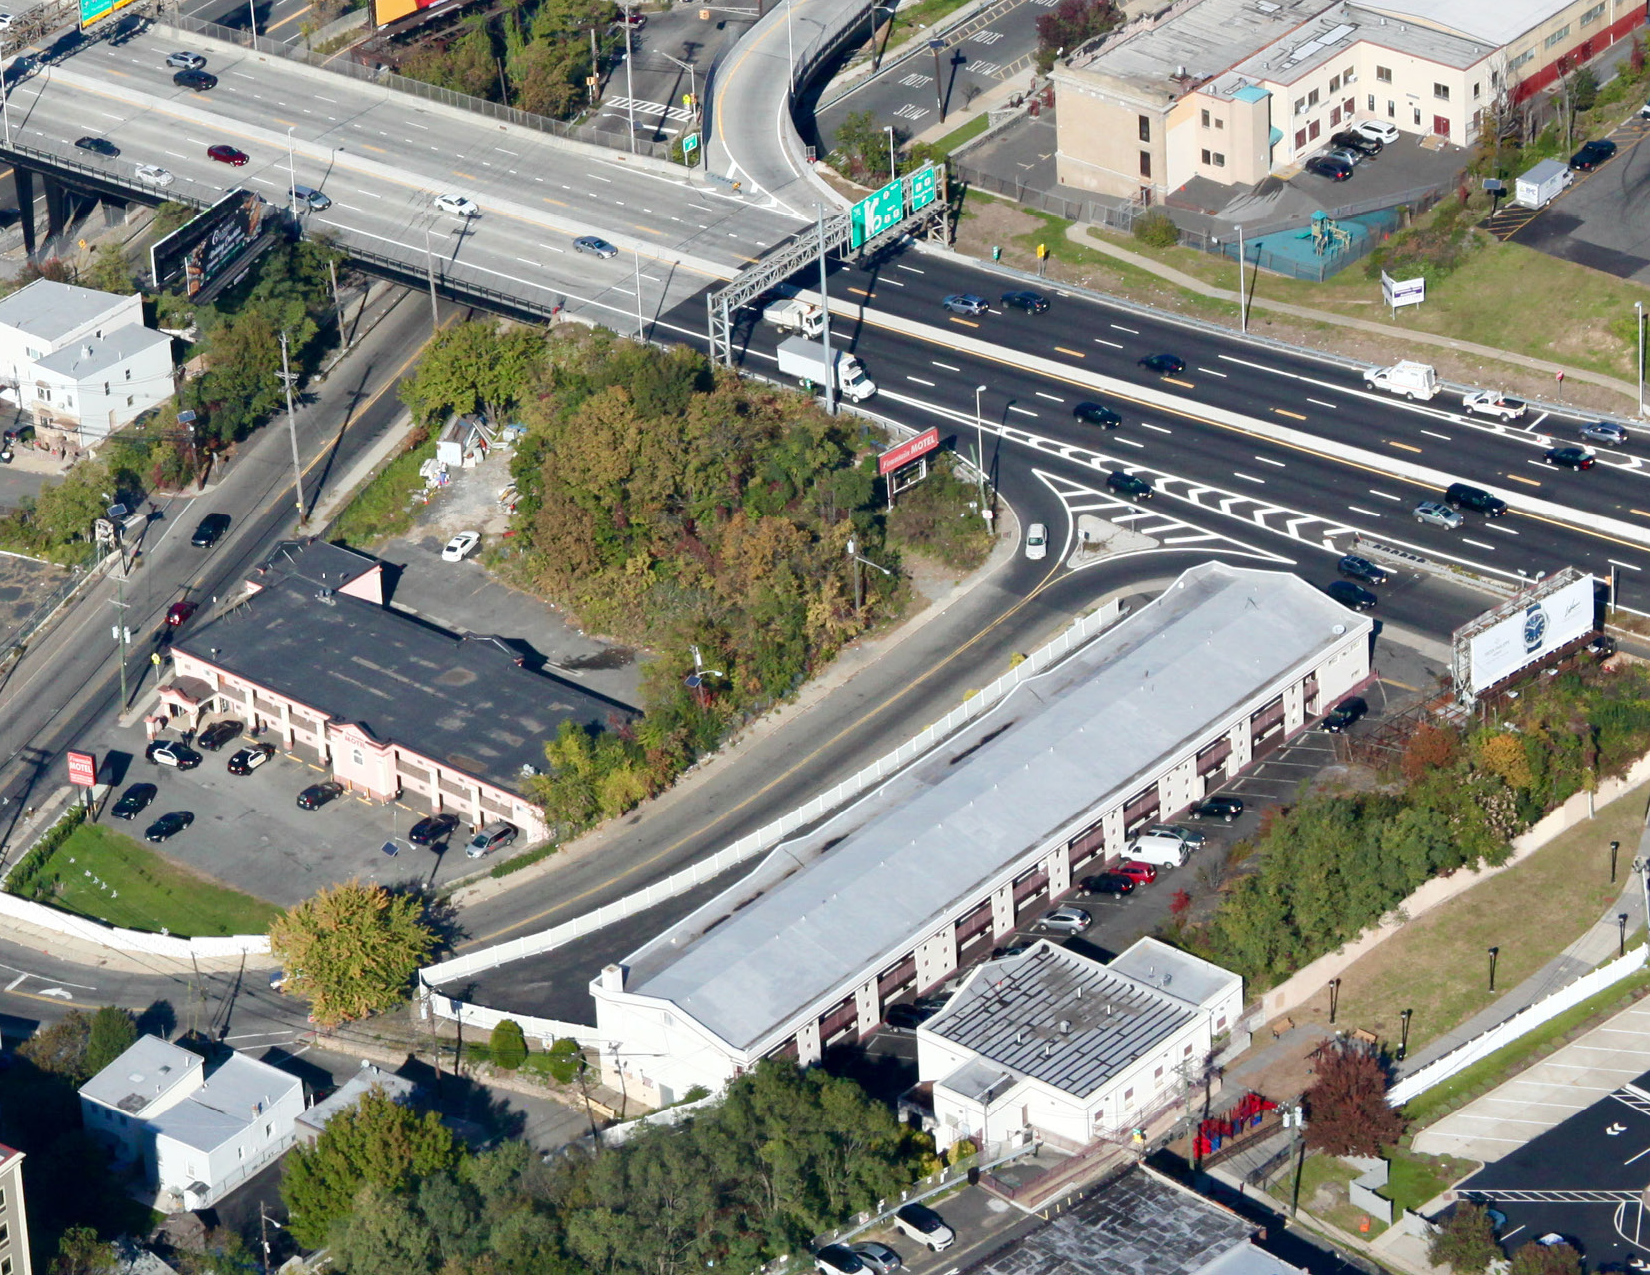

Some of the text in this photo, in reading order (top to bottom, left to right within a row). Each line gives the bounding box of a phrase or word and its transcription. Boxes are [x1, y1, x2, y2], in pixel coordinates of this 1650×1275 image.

[968, 29, 1004, 45] SLOW
[965, 60, 1001, 76] SLOW
[898, 72, 933, 89] SLOW
[893, 103, 930, 121] SLOW
[910, 435, 935, 454] MOTEL
[69, 762, 92, 773] MOTEL
